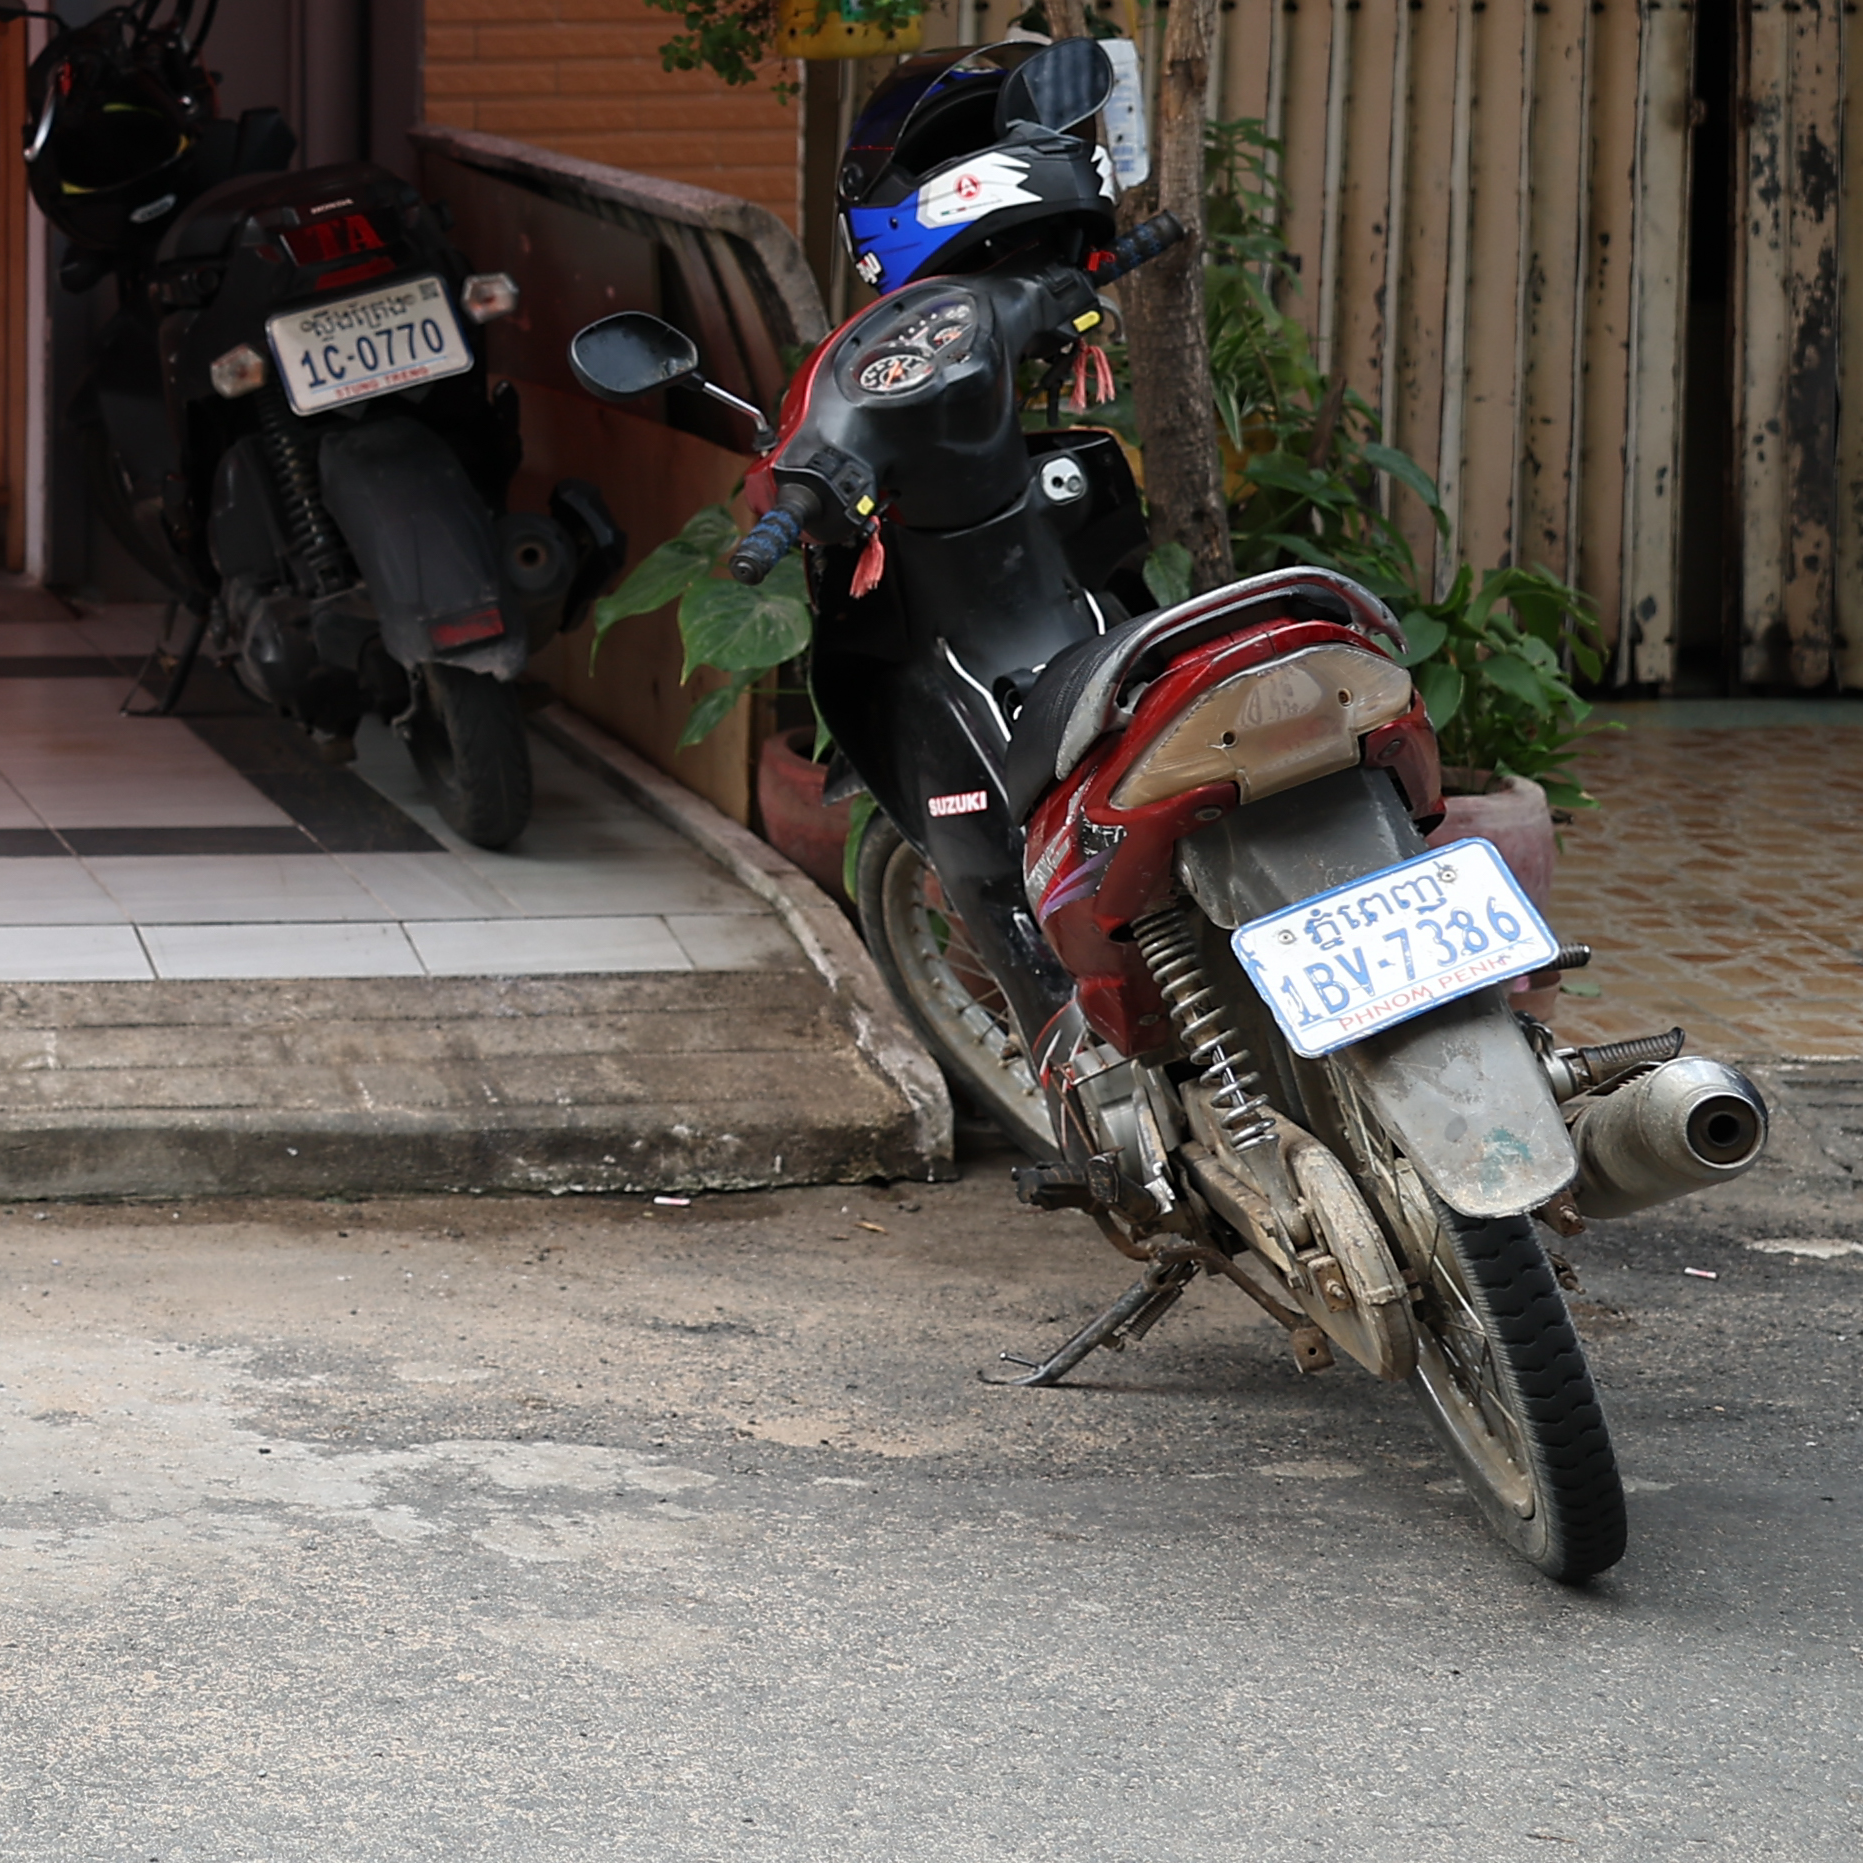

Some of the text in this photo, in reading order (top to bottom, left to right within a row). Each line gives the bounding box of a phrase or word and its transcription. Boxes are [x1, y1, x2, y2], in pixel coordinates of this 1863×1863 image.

[301, 318, 445, 388] 1C-0770
[335, 365, 431, 400] STUNG TRENG
[927, 789, 988, 818] SUZUKI
[1304, 873, 1447, 951] ភ្នំពេញ
[1280, 895, 1522, 1028] 1BV-7386
[1338, 952, 1513, 1032] PHNOM PENH
